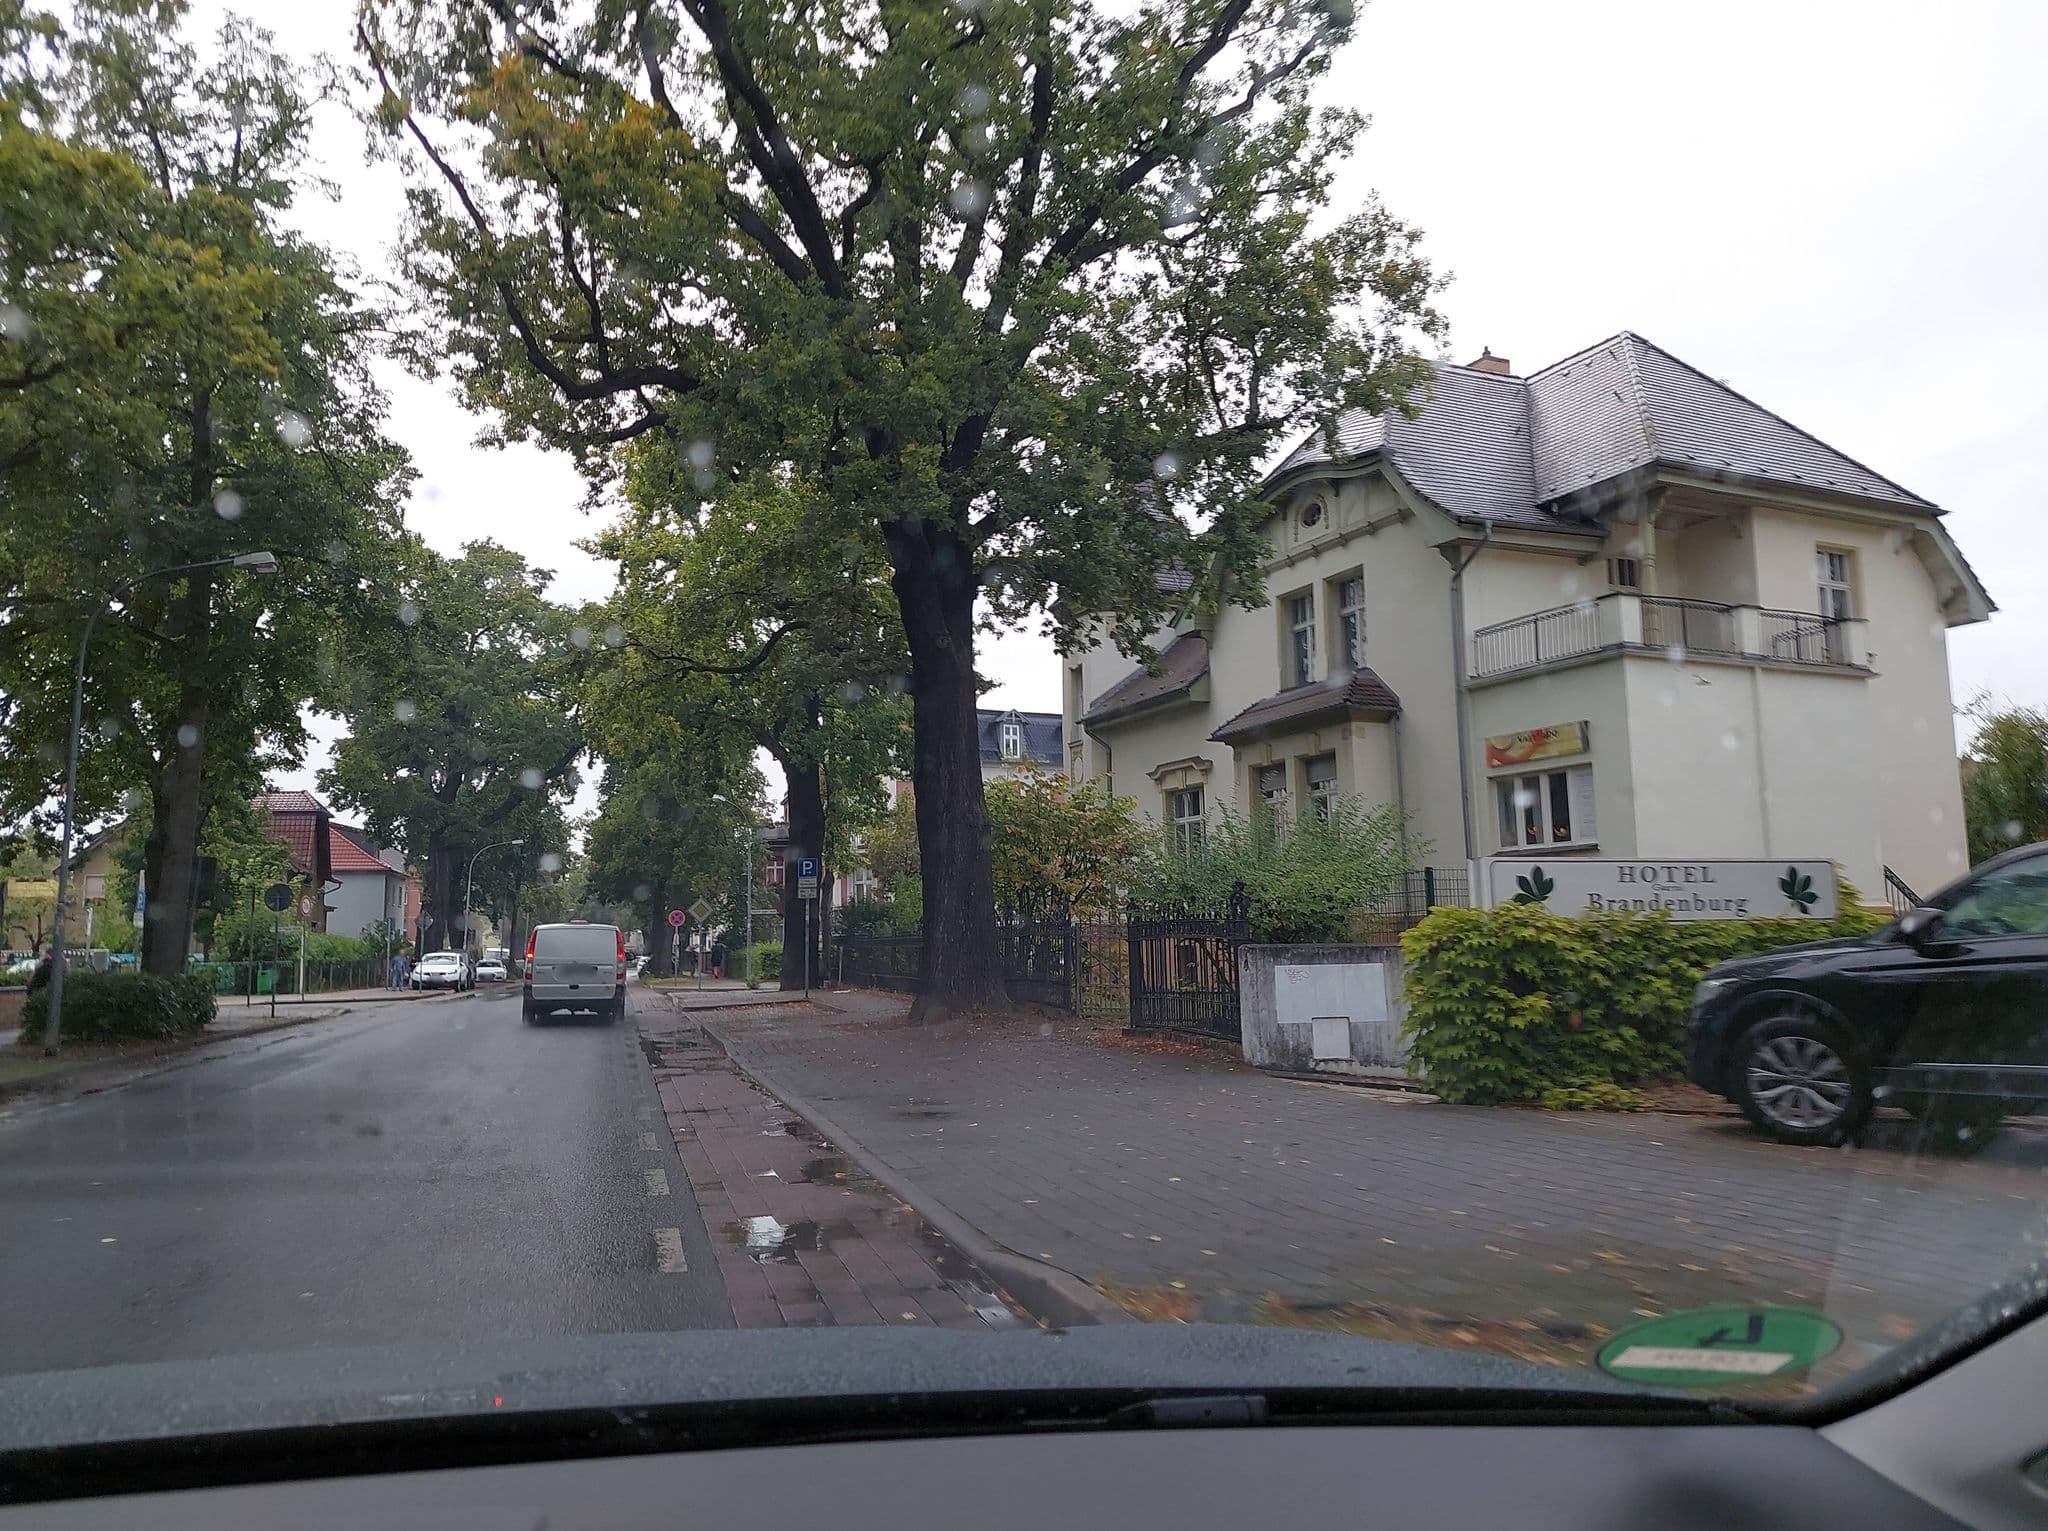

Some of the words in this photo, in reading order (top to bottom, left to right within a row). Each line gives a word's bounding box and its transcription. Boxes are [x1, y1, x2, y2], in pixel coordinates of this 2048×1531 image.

[802, 860, 813, 875] P
[1617, 865, 1717, 884] HOTEL
[1587, 893, 1750, 918] Brandenburg
